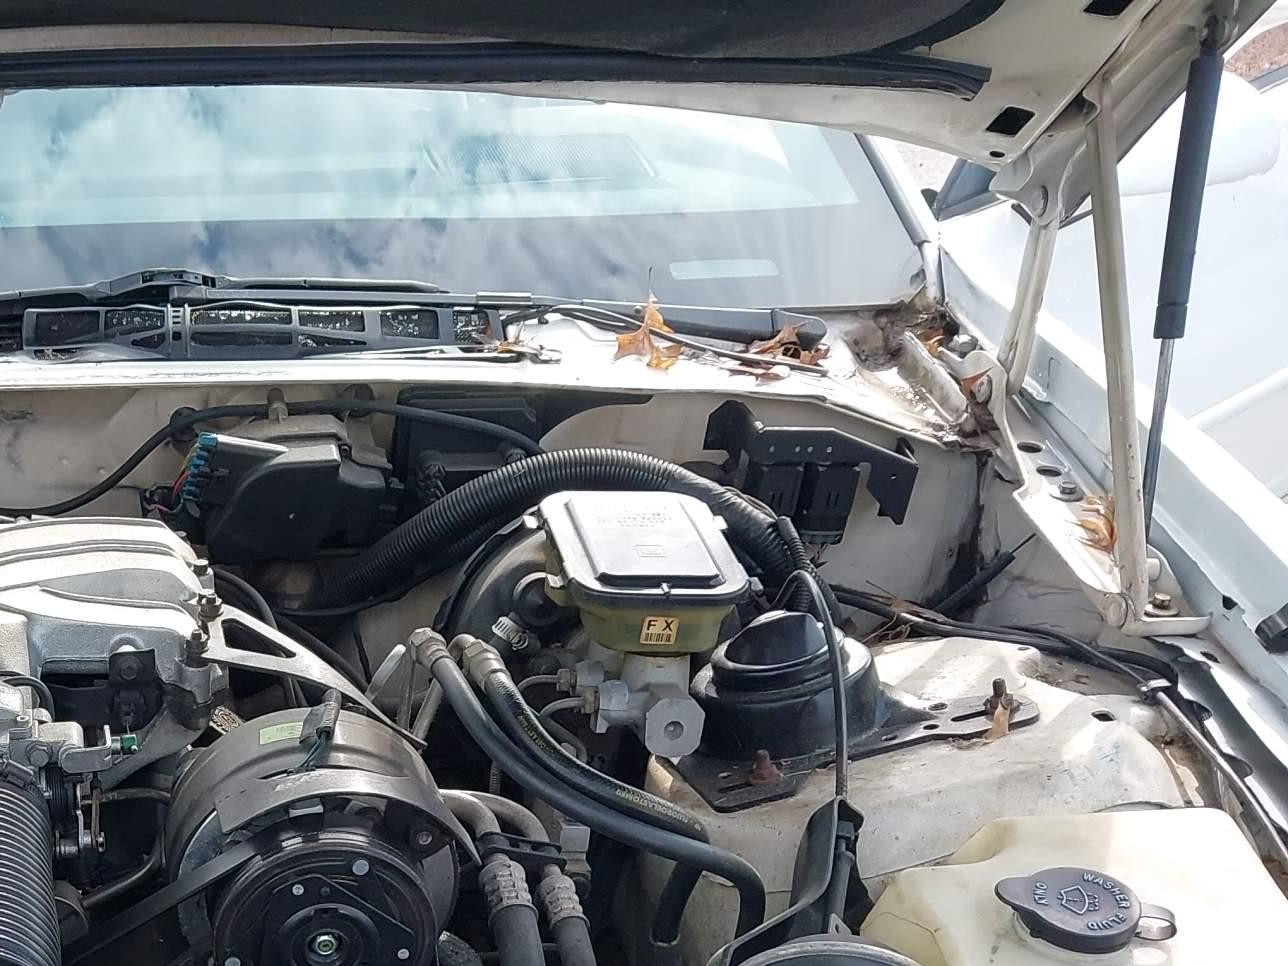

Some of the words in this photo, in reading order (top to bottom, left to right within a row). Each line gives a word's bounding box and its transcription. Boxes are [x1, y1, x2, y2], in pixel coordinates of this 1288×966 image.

[1034, 882, 1049, 906] ONLY
[1083, 872, 1130, 908] WASHER
[1087, 912, 1127, 930] FLUID
